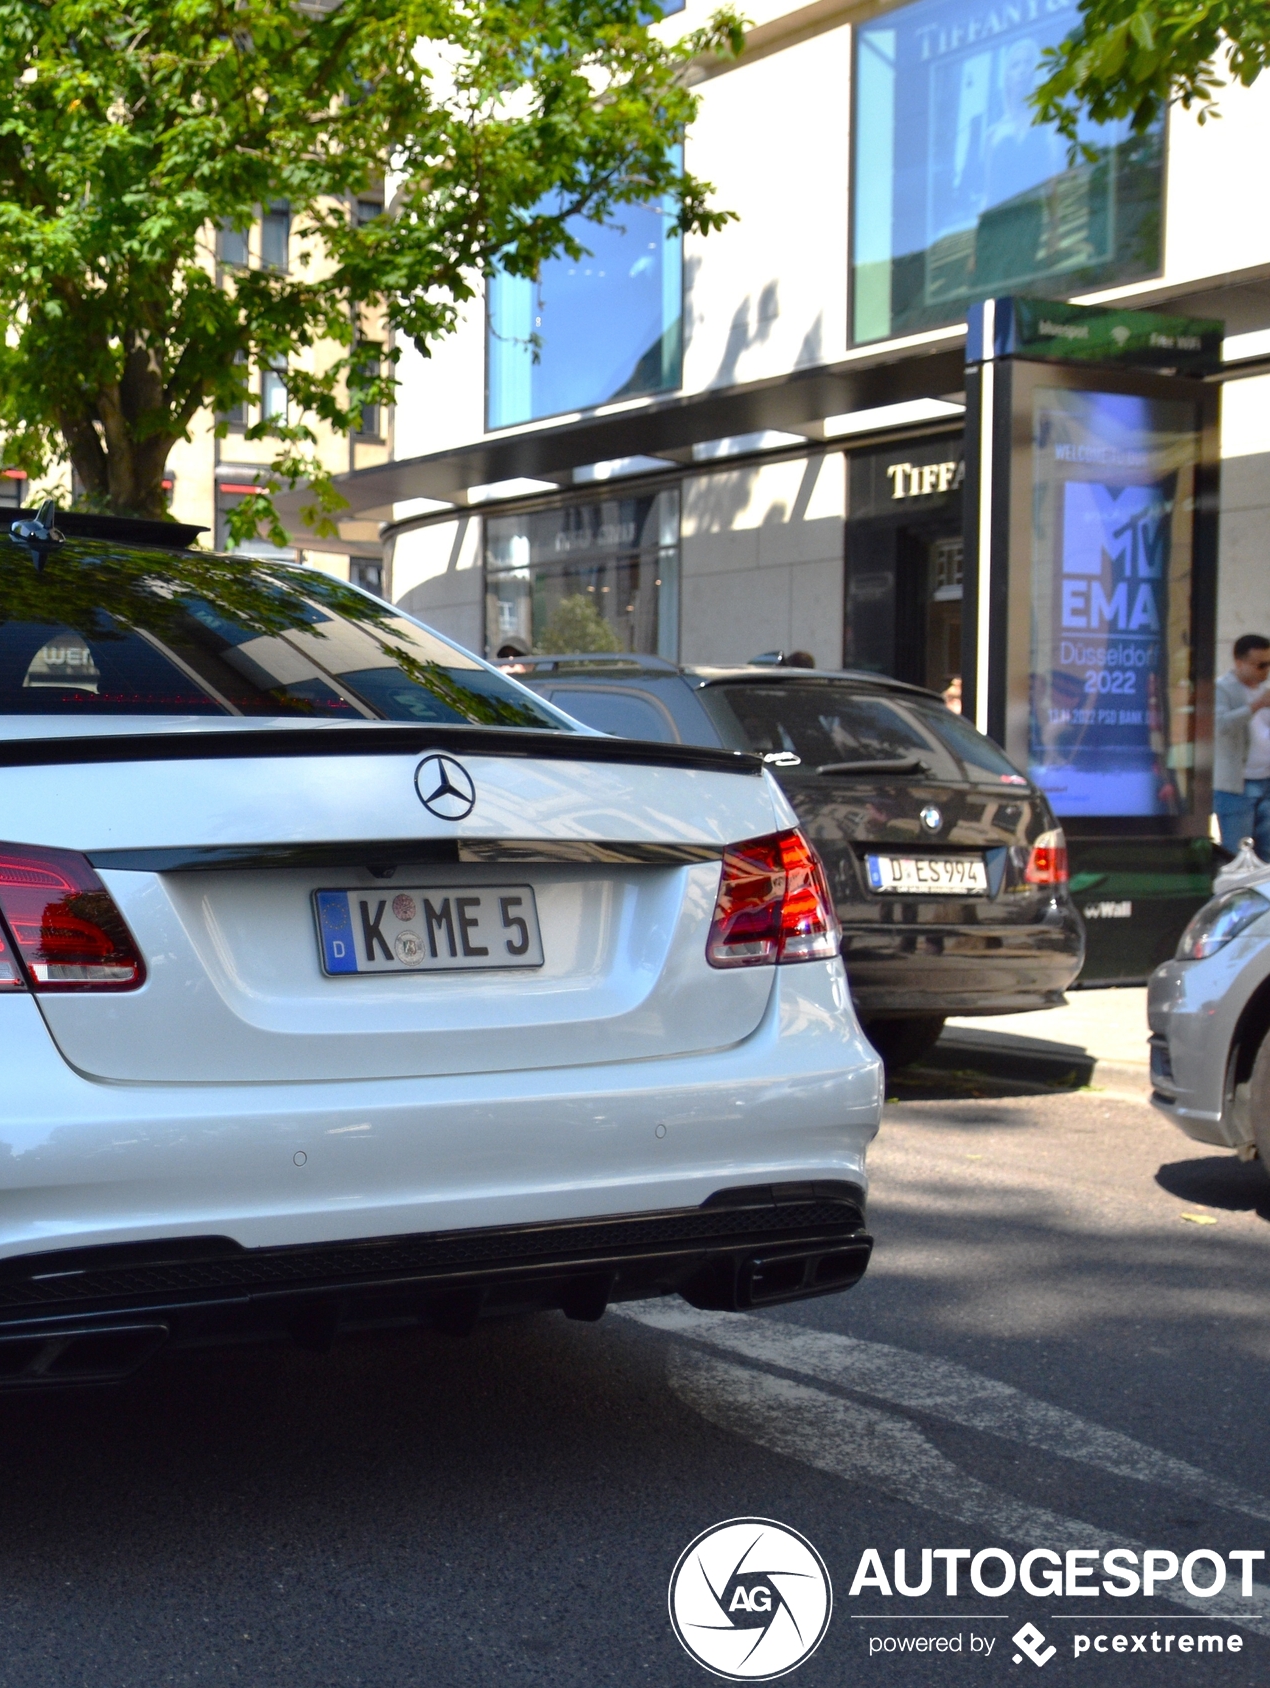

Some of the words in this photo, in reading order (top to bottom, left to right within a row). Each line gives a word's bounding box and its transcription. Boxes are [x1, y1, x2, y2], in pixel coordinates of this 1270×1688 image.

[1062, 481, 1162, 578] MTV
[1062, 579, 1160, 630] EMA
[1060, 640, 1160, 667] Düsseldorf
[1084, 669, 1137, 694] 2022
[891, 859, 903, 882] D
[359, 900, 395, 961] K
[423, 897, 490, 958] ME
[499, 896, 530, 955] 5
[333, 940, 346, 958] D
